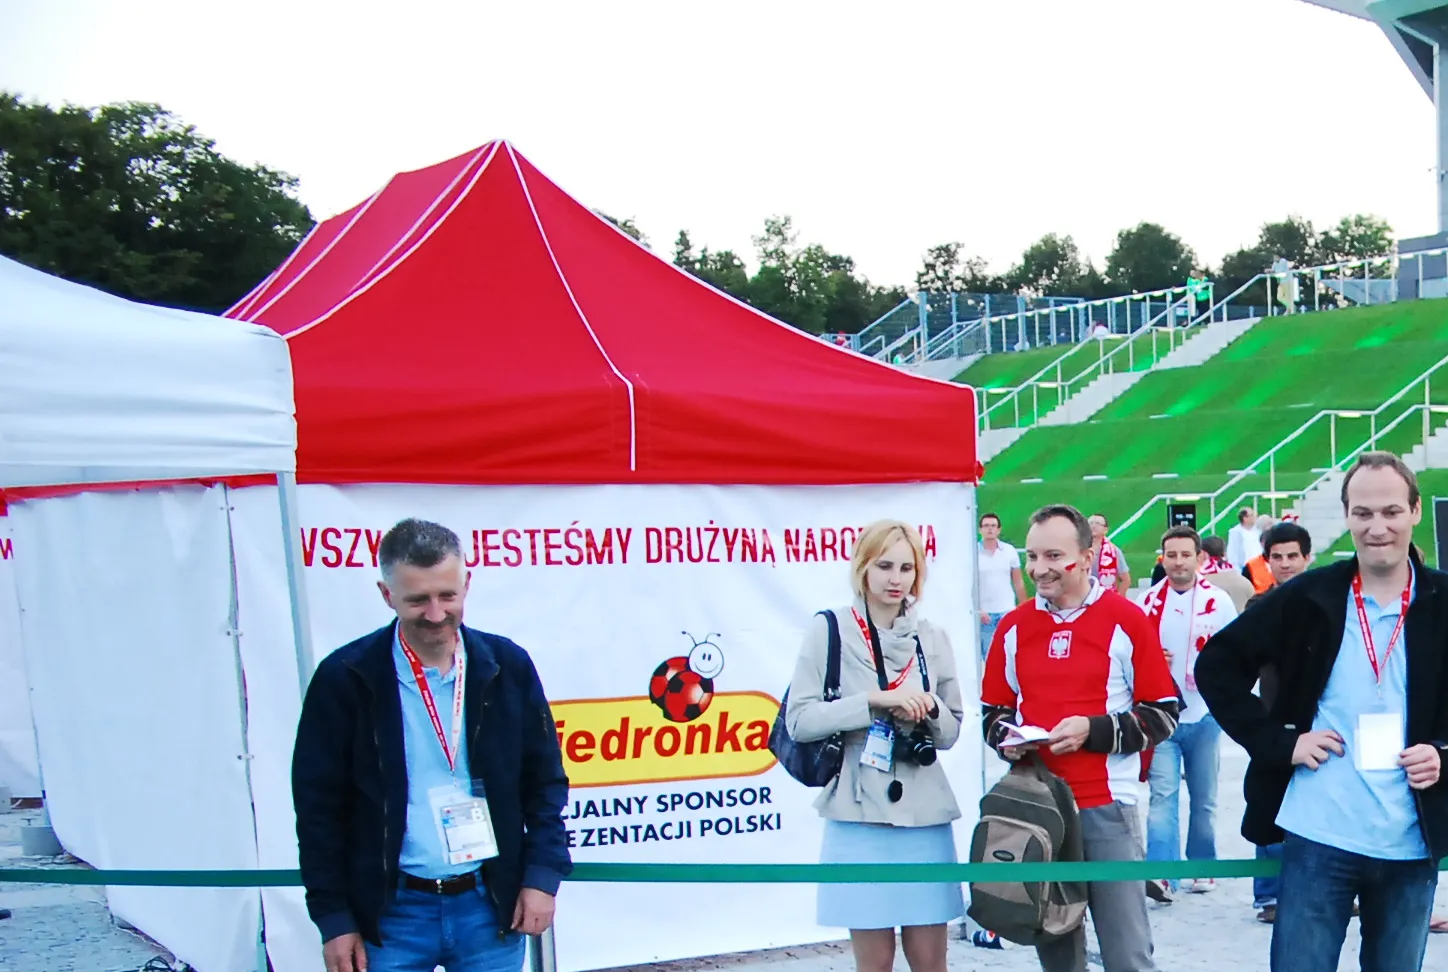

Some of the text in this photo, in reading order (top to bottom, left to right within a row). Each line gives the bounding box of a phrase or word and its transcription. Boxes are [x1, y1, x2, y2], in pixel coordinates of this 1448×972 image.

[465, 520, 632, 567] JESTEŚMY
[645, 519, 776, 568] DRUŻYNĄ
[784, 524, 937, 563] NAROĄ
[556, 711, 770, 763] iedronka
[560, 786, 772, 820] JALNY SPONSOR
[565, 812, 782, 848] EZENTACJI POLSKI
